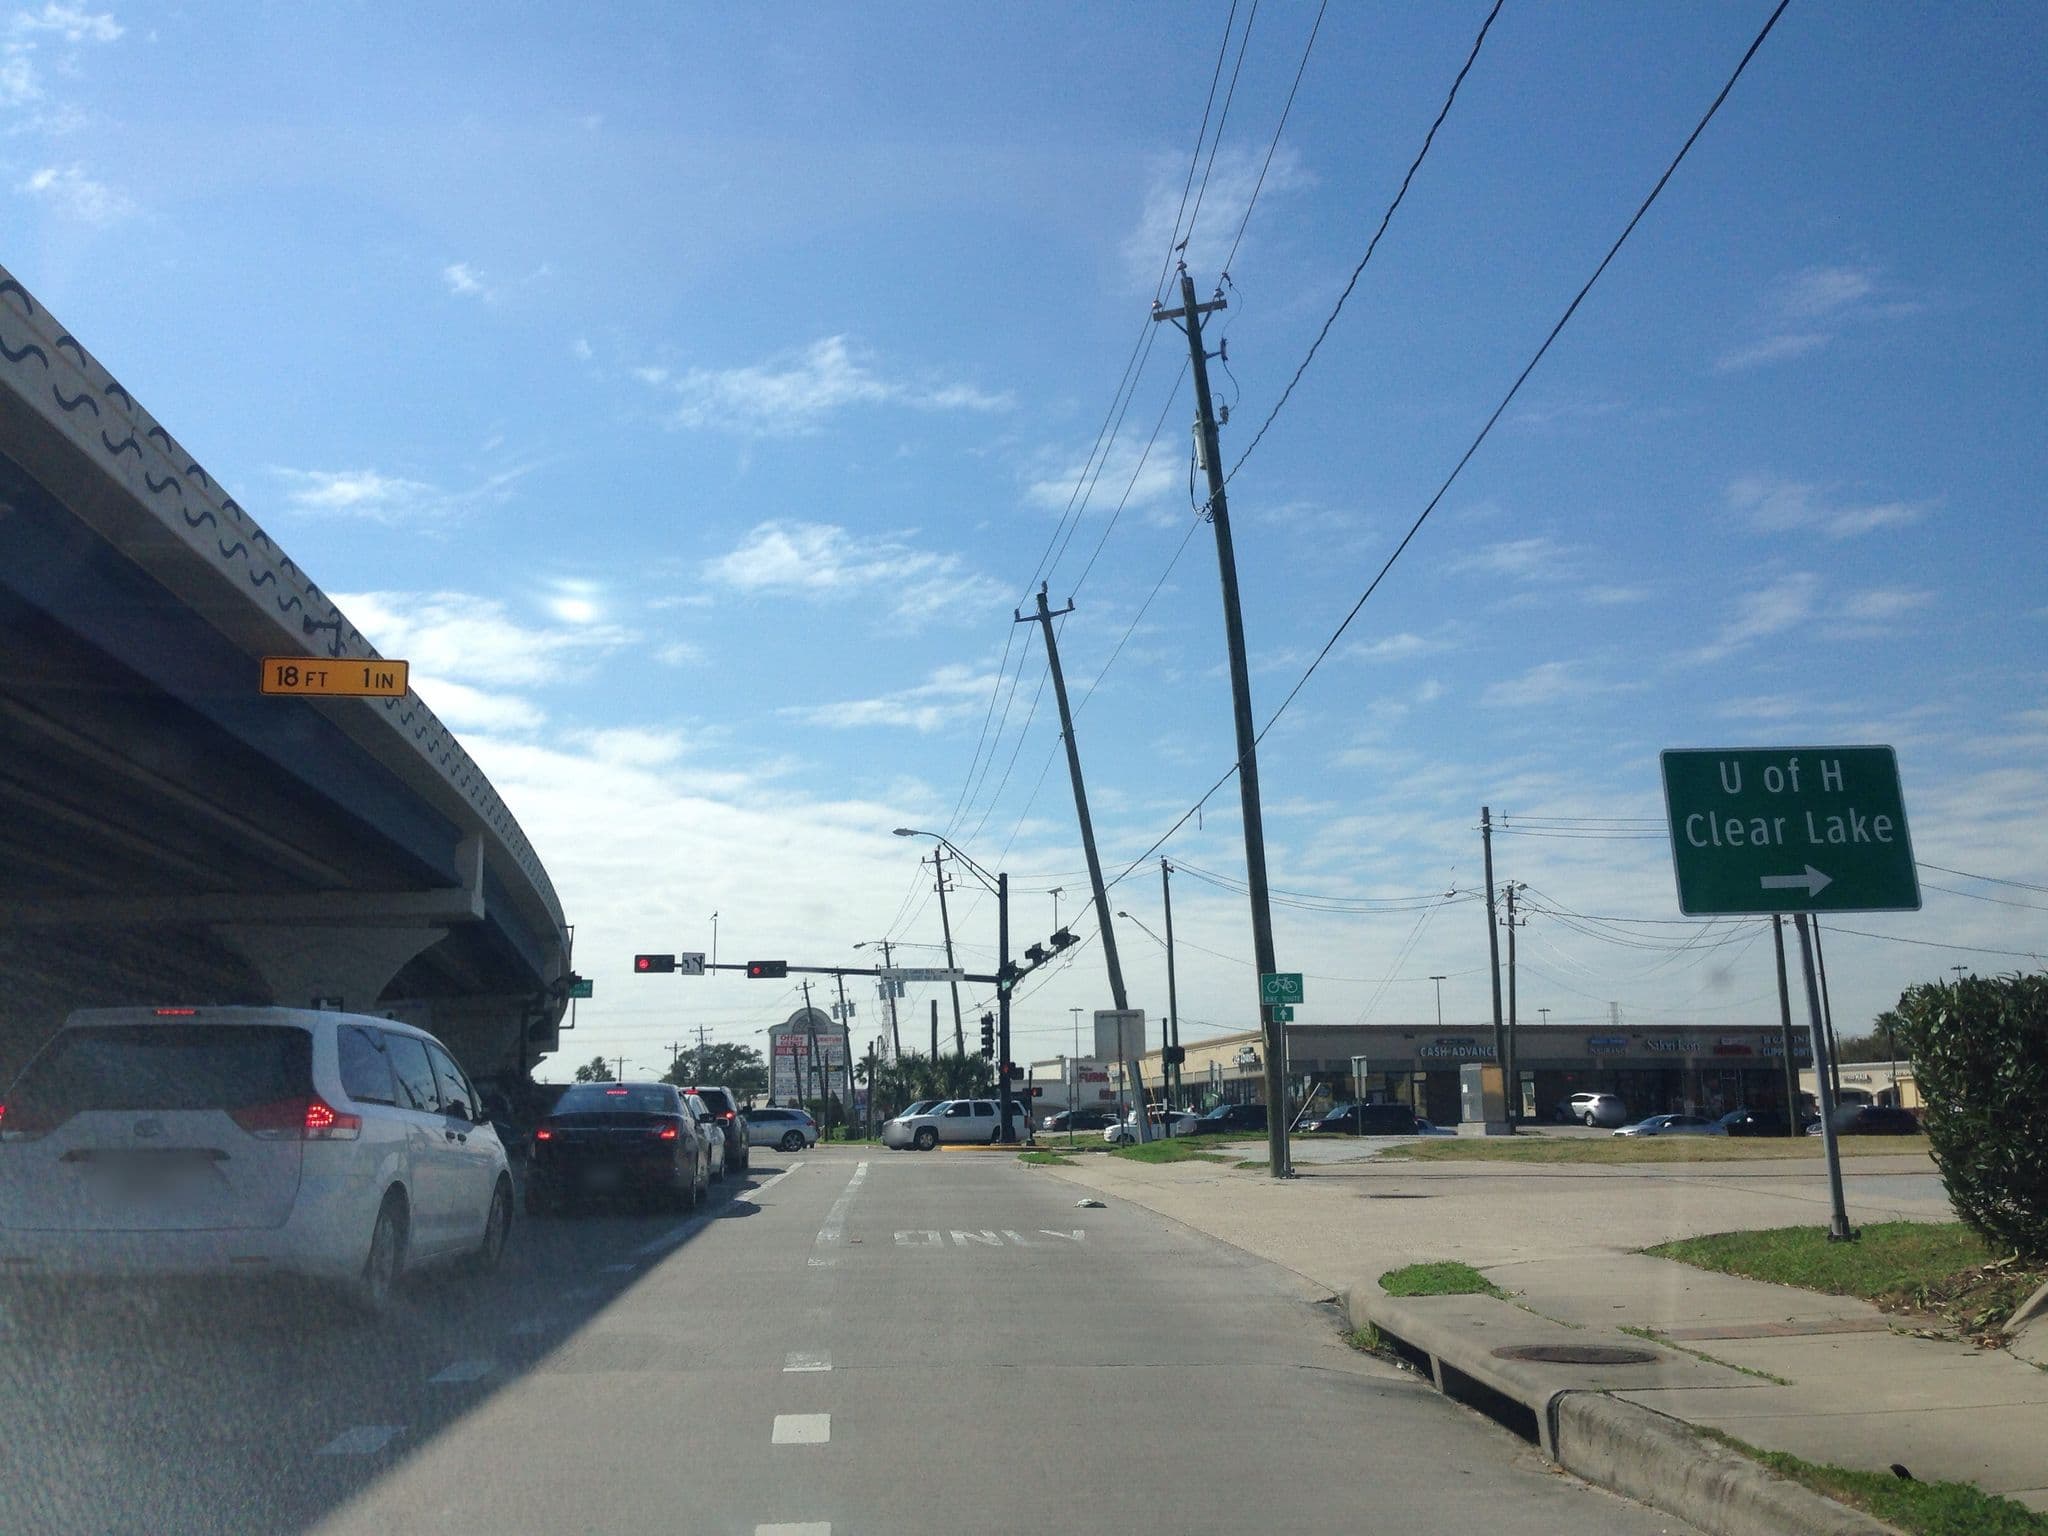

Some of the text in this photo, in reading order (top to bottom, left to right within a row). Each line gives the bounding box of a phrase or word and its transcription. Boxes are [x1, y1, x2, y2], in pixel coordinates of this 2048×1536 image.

[276, 666, 394, 689] 18 FT 1 IN
[1719, 757, 1844, 793] U of H
[1685, 807, 1893, 847] Clear Lake
[1420, 1047, 1448, 1057] CASH
[893, 1229, 1086, 1248] ONLY
